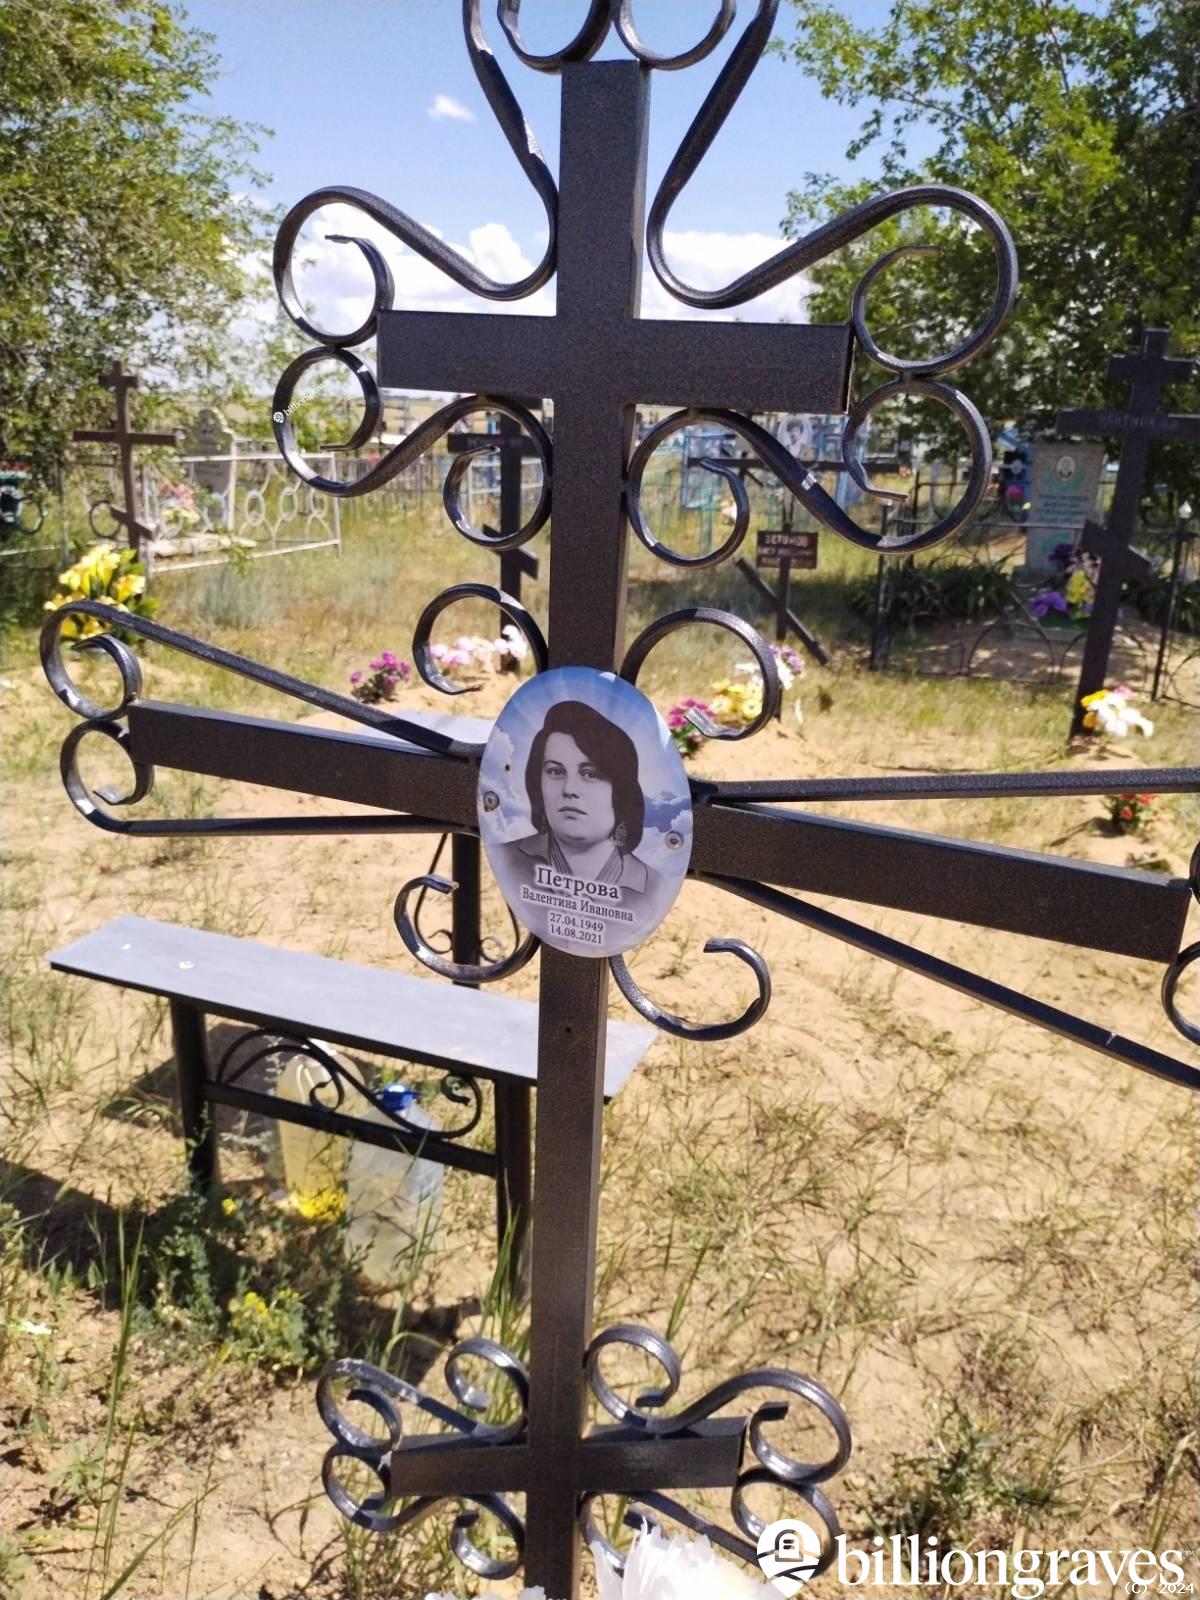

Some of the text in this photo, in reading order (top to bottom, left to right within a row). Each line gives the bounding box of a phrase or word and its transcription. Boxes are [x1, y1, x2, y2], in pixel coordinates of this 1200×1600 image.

[537, 867, 619, 899] Петрова
[522, 887, 633, 921] Валентина Ивановна
[549, 912, 604, 932] 27.04.1949
[550, 923, 602, 944] 14.08.2021
